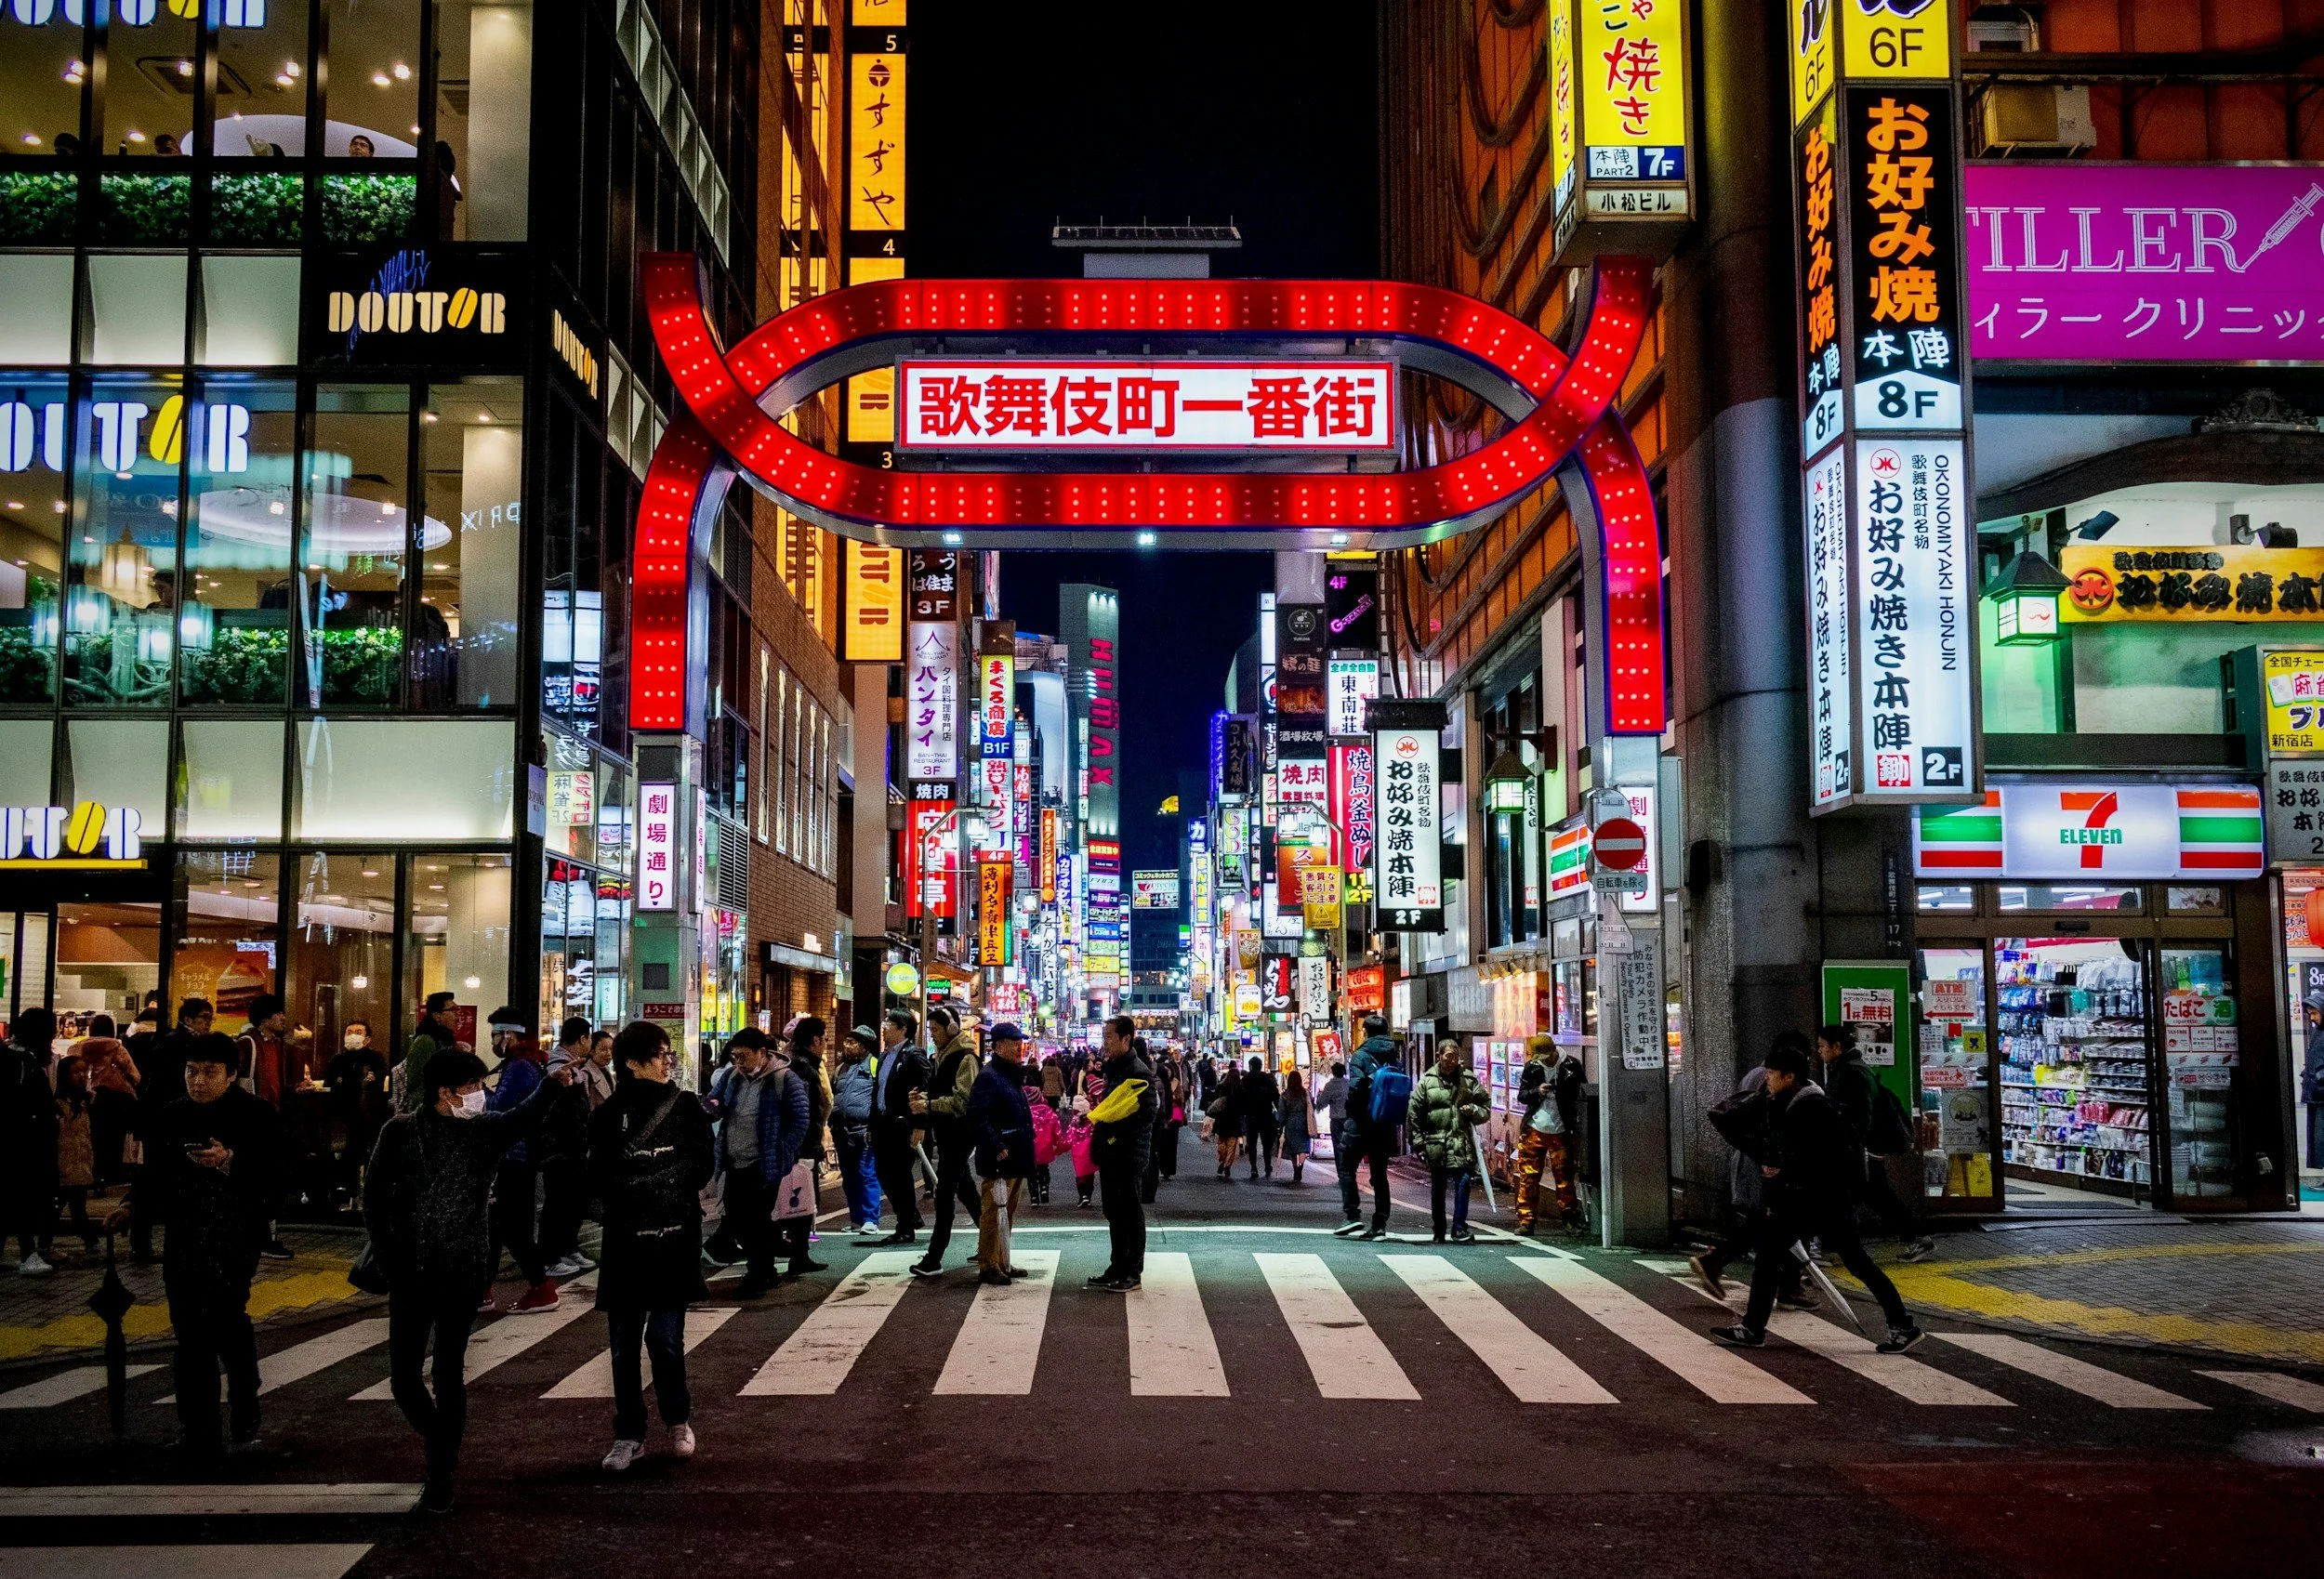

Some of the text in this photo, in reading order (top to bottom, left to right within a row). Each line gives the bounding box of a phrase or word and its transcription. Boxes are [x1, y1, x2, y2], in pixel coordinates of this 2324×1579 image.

[886, 35, 897, 52] 5
[1869, 28, 1924, 68] 6F
[1805, 48, 1825, 102] 6F
[863, 93, 897, 226] すずや
[1595, 149, 1630, 164] 本陣
[1596, 165, 1633, 177] PART2
[1644, 148, 1674, 176] 7F
[1602, 193, 1670, 212] 小松ビル
[1867, 97, 1940, 322] お好み焼
[883, 239, 895, 256] 4
[1805, 123, 1836, 353] お好み焼
[1968, 207, 2244, 273] ILLER
[328, 287, 506, 334] DOUTOR
[2123, 297, 2324, 340] クリニッ
[554, 309, 599, 400] DOUTOR
[1864, 326, 1950, 370] 本陣
[1808, 342, 1841, 395] 本陣
[918, 374, 1376, 438] 歌舞伎町一番街
[1877, 380, 1938, 419] 8F
[1815, 400, 1836, 441] 8F
[882, 452, 892, 468] 3
[1911, 454, 1930, 550] 歌舞伎町名物
[1934, 454, 1957, 671] OKONOMIYAKI HONJIN
[1329, 576, 1347, 589] 4F
[2116, 572, 2324, 612] お好み焼本
[917, 600, 950, 614] 3F
[1868, 480, 1912, 751] お好み焼き本陣
[1814, 502, 1831, 764] お好み焼き本陣
[1330, 663, 1376, 673] 全卓全自動
[915, 665, 938, 747] バンタイ
[942, 666, 952, 742] タイ国料理専門店
[988, 660, 1006, 737] まぐろ商店
[1341, 676, 1357, 734] 東南荘
[984, 743, 1010, 754] B1F
[2272, 733, 2314, 747] 新宿店
[923, 766, 941, 775] 3F
[1282, 764, 1325, 785] 焼肉
[1836, 758, 1848, 786] 2F
[1925, 752, 1961, 781] 2F
[917, 783, 948, 799] 焼肉
[1348, 749, 1371, 870] 焼鳥釜めし
[1387, 759, 1415, 898] お好み焼本陣
[646, 794, 667, 900] 劇場通り
[988, 852, 1006, 861] 4F
[1305, 872, 1336, 881] 悪質な
[1305, 884, 1336, 892] 客引き
[1597, 876, 1644, 889] 自転車を除く
[1305, 894, 1336, 903] に注意
[1348, 889, 1373, 902] 2F
[1395, 910, 1421, 925] 2F
[1889, 925, 1900, 935] 17
[1089, 961, 1108, 969] ゲーム
[1633, 950, 1650, 1047] 防犯カメラ作動中
[1644, 943, 1658, 1052] みなさまの安全を守ります
[1870, 991, 1878, 1002] 5
[2165, 999, 2206, 1019] たばこ
